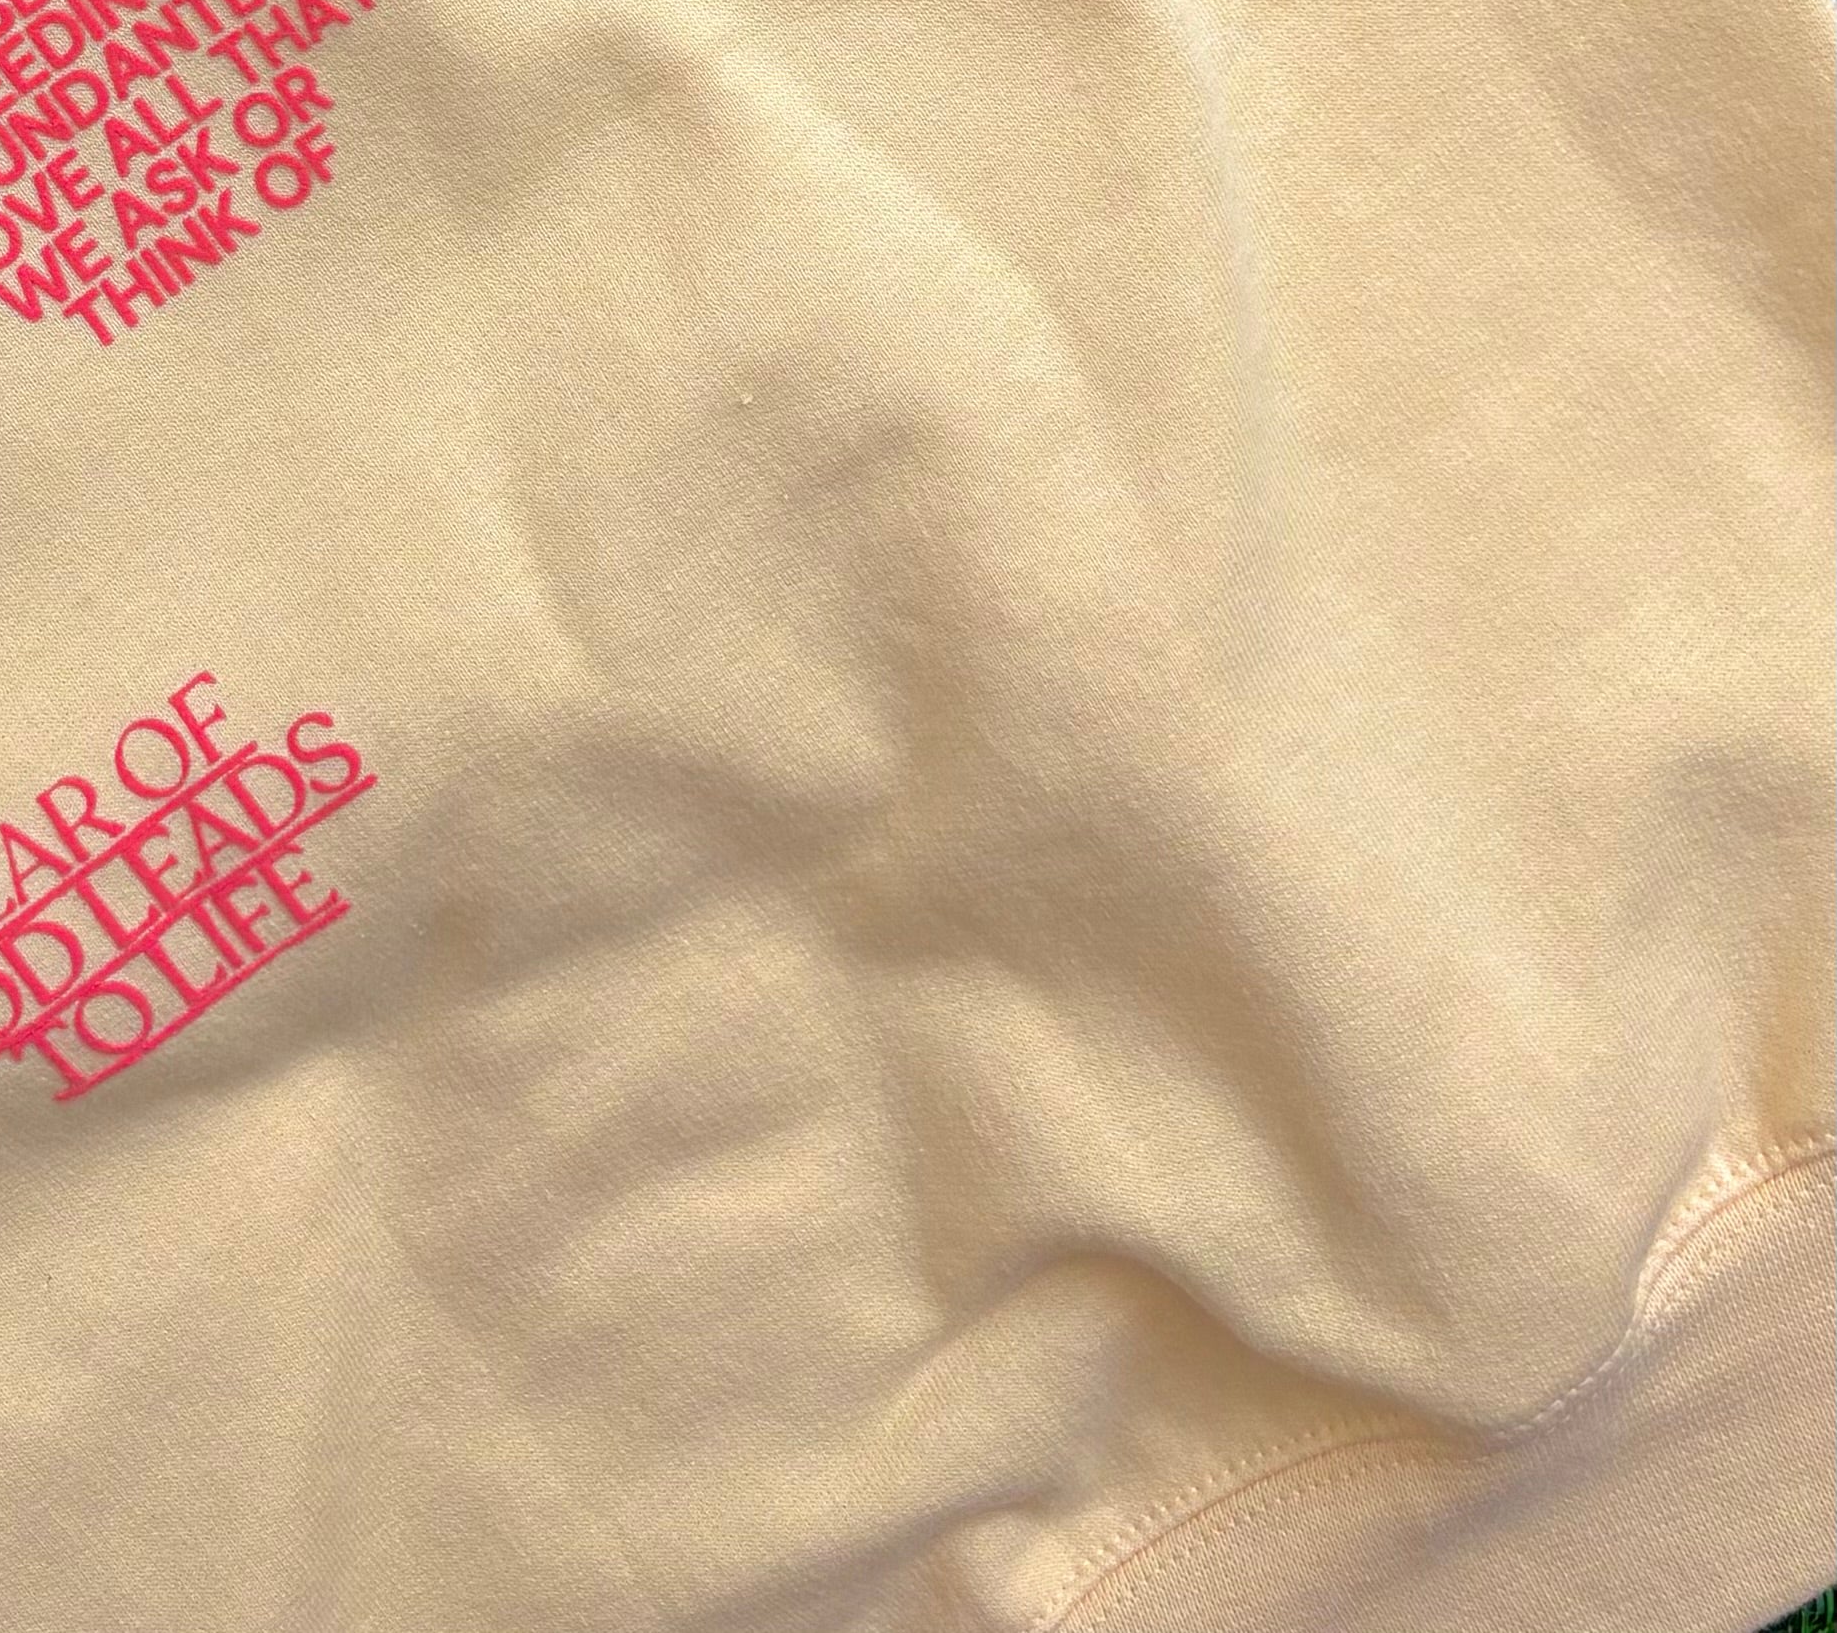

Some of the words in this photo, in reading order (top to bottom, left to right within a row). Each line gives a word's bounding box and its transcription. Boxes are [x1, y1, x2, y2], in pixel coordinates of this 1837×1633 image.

[103, 74, 224, 178] ALL
[112, 127, 240, 249] ASK
[233, 64, 334, 146] OR
[63, 189, 262, 348] THINK
[254, 124, 336, 210] OF
[76, 711, 363, 951] LEADS
[114, 670, 228, 800] OF
[8, 980, 153, 1102] TO
[143, 838, 340, 1008] LIFE
